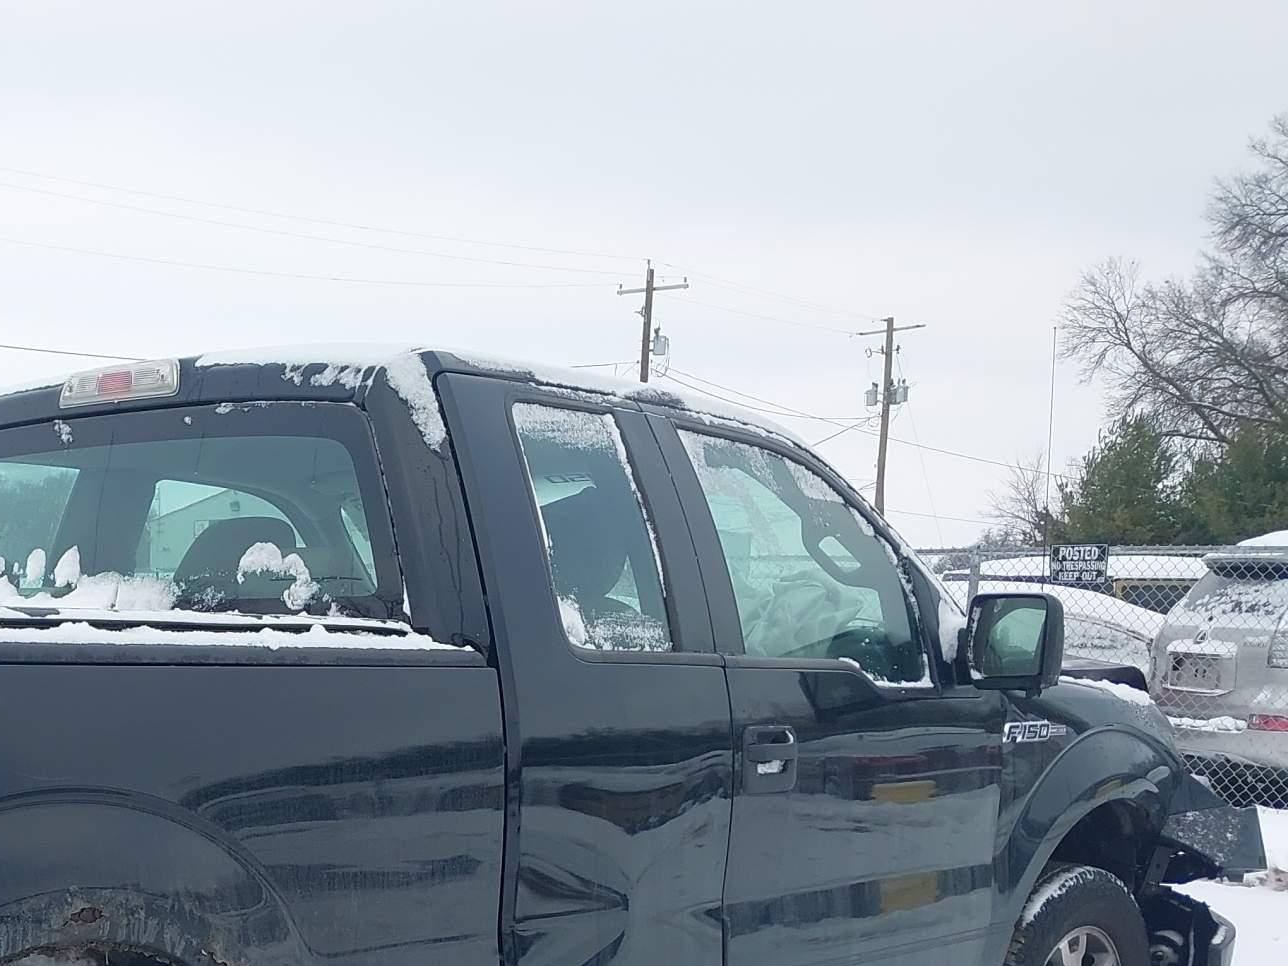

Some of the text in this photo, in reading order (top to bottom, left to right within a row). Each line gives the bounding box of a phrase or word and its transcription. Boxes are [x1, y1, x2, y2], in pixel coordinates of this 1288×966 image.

[1058, 546, 1099, 561] POSTED
[1051, 560, 1106, 571] NO TRESPASSING
[1058, 570, 1080, 581] KEEP
[1081, 570, 1098, 581] OUT
